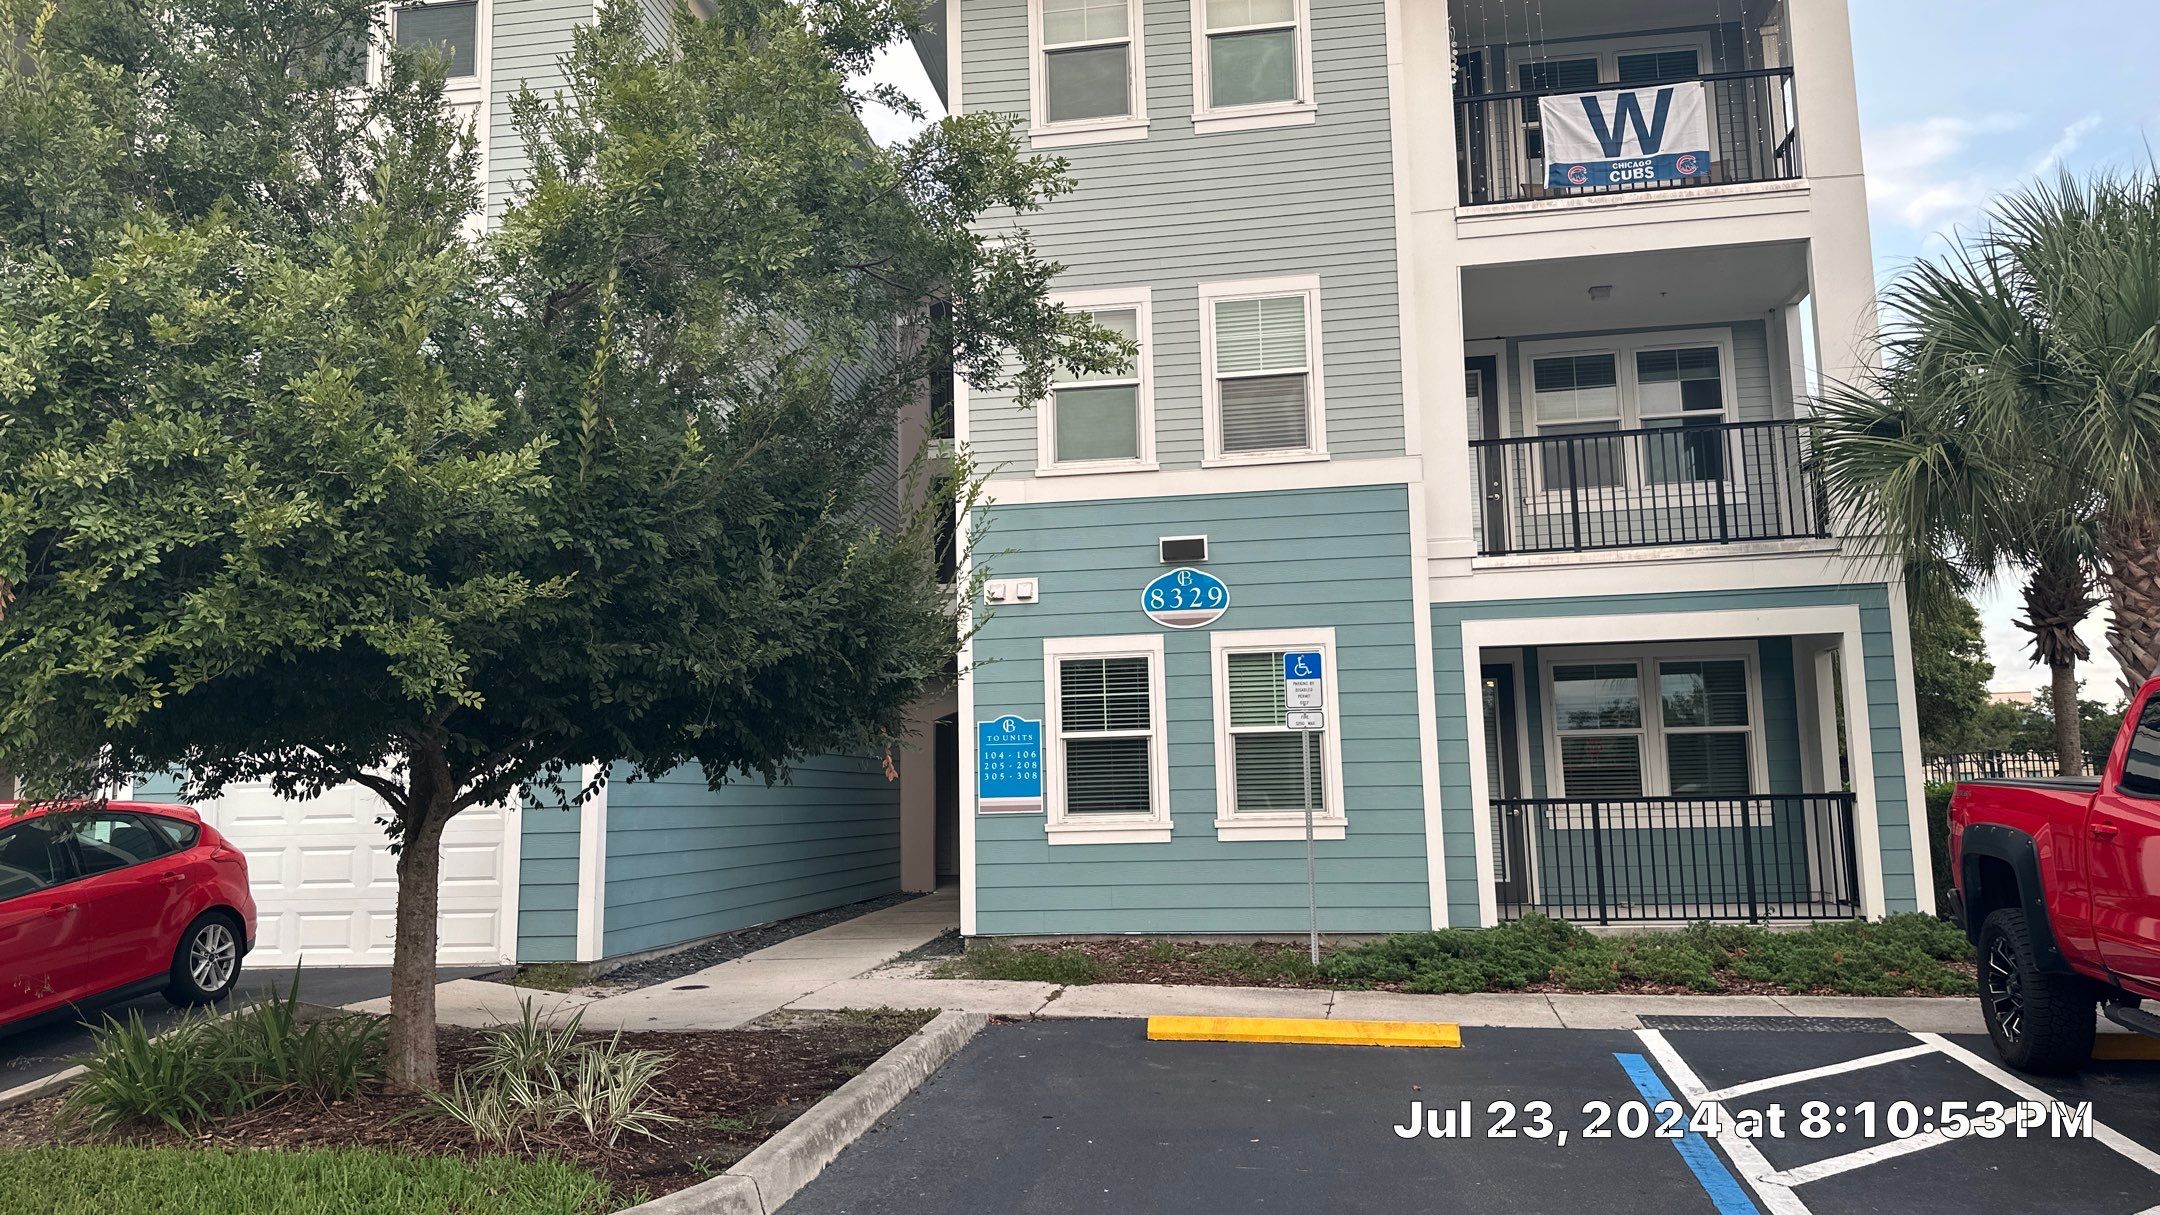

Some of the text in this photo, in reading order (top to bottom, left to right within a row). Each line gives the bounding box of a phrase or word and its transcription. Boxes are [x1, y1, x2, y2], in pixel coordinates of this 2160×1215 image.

[1580, 87, 1674, 158] W
[1612, 159, 1652, 170] CHICAGO
[1609, 166, 1655, 182] CUBS
[1150, 586, 1223, 609] 8329
[1002, 734, 1033, 742] UNITS
[984, 751, 1005, 760] 104
[1017, 750, 1037, 759] 106
[984, 762, 1005, 770] 205
[1016, 761, 1038, 769] 208
[984, 772, 1005, 781] 305
[1017, 771, 1038, 780] 308
